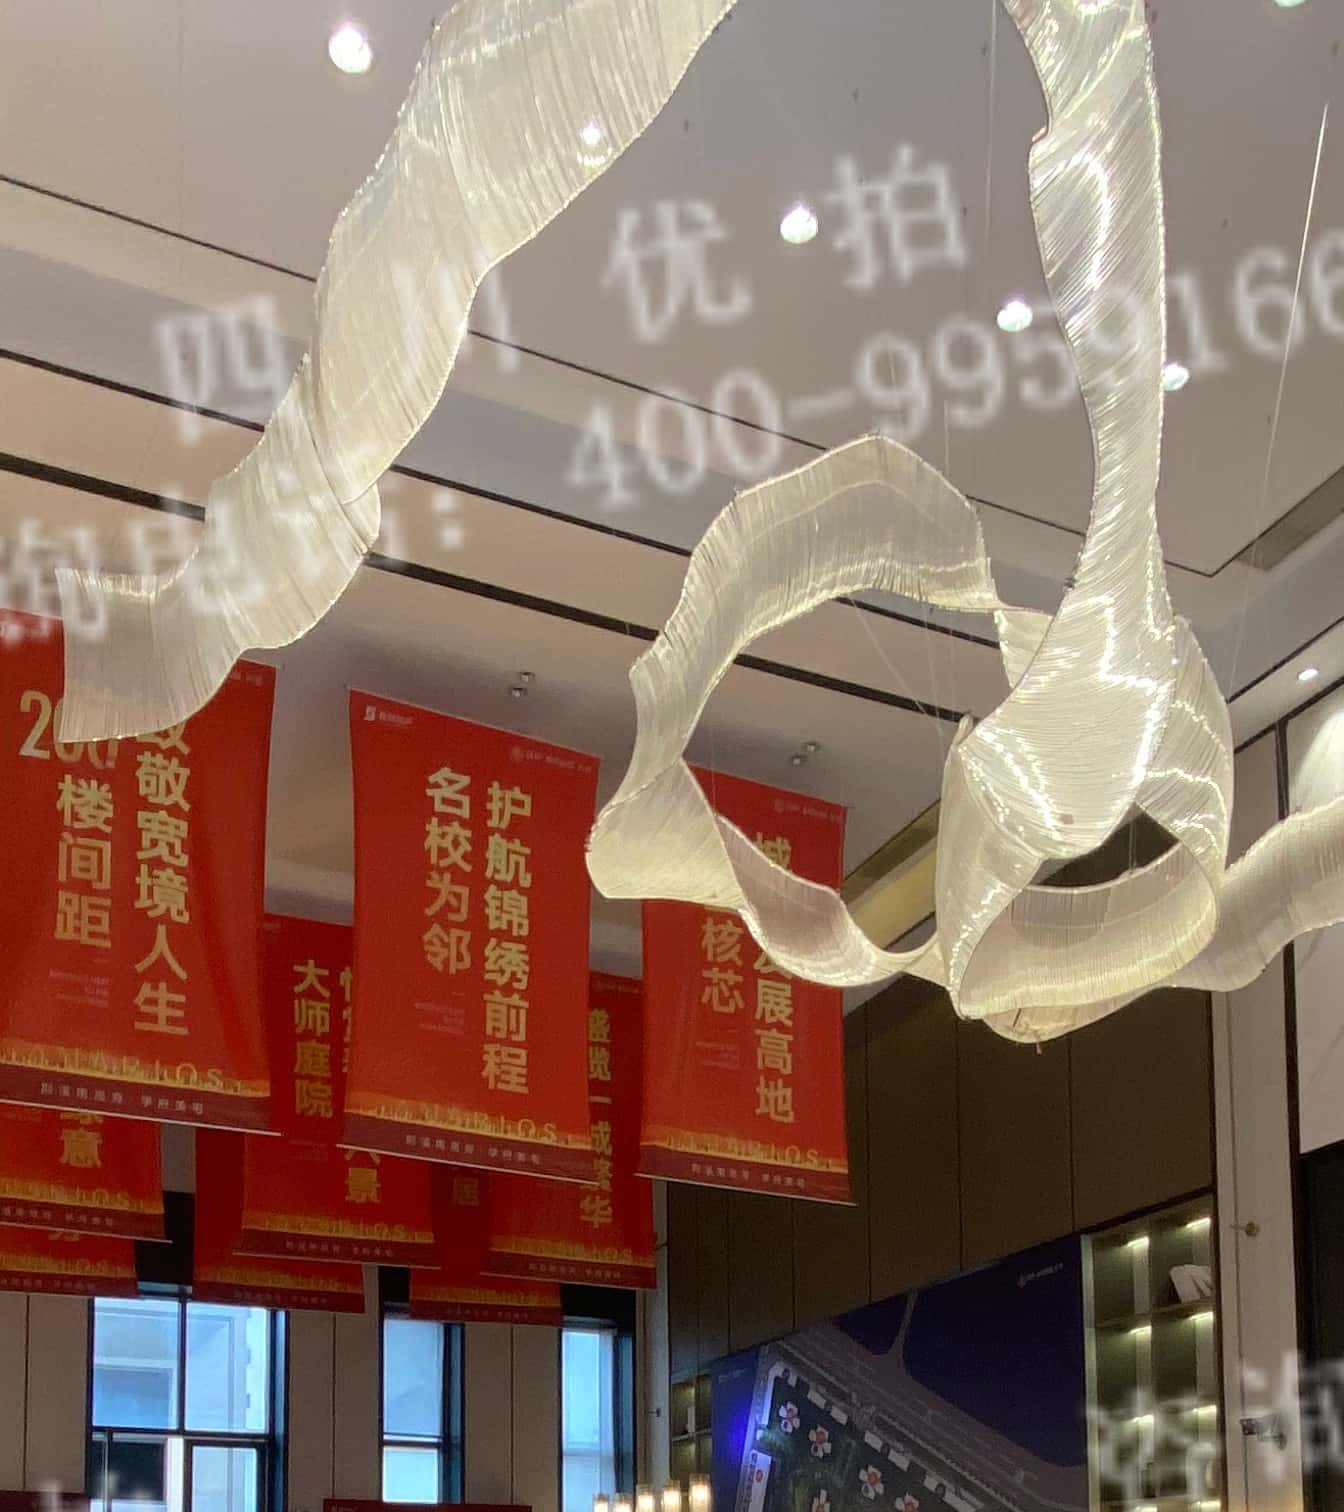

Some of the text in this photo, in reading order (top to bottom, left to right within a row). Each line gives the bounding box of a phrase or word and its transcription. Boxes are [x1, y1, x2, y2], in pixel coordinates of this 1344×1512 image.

[422, 767, 473, 975] 名校为邻
[480, 781, 532, 1095] 护航锦绣前程
[701, 905, 744, 1013] 核芯
[293, 960, 332, 1118] 大师庭院
